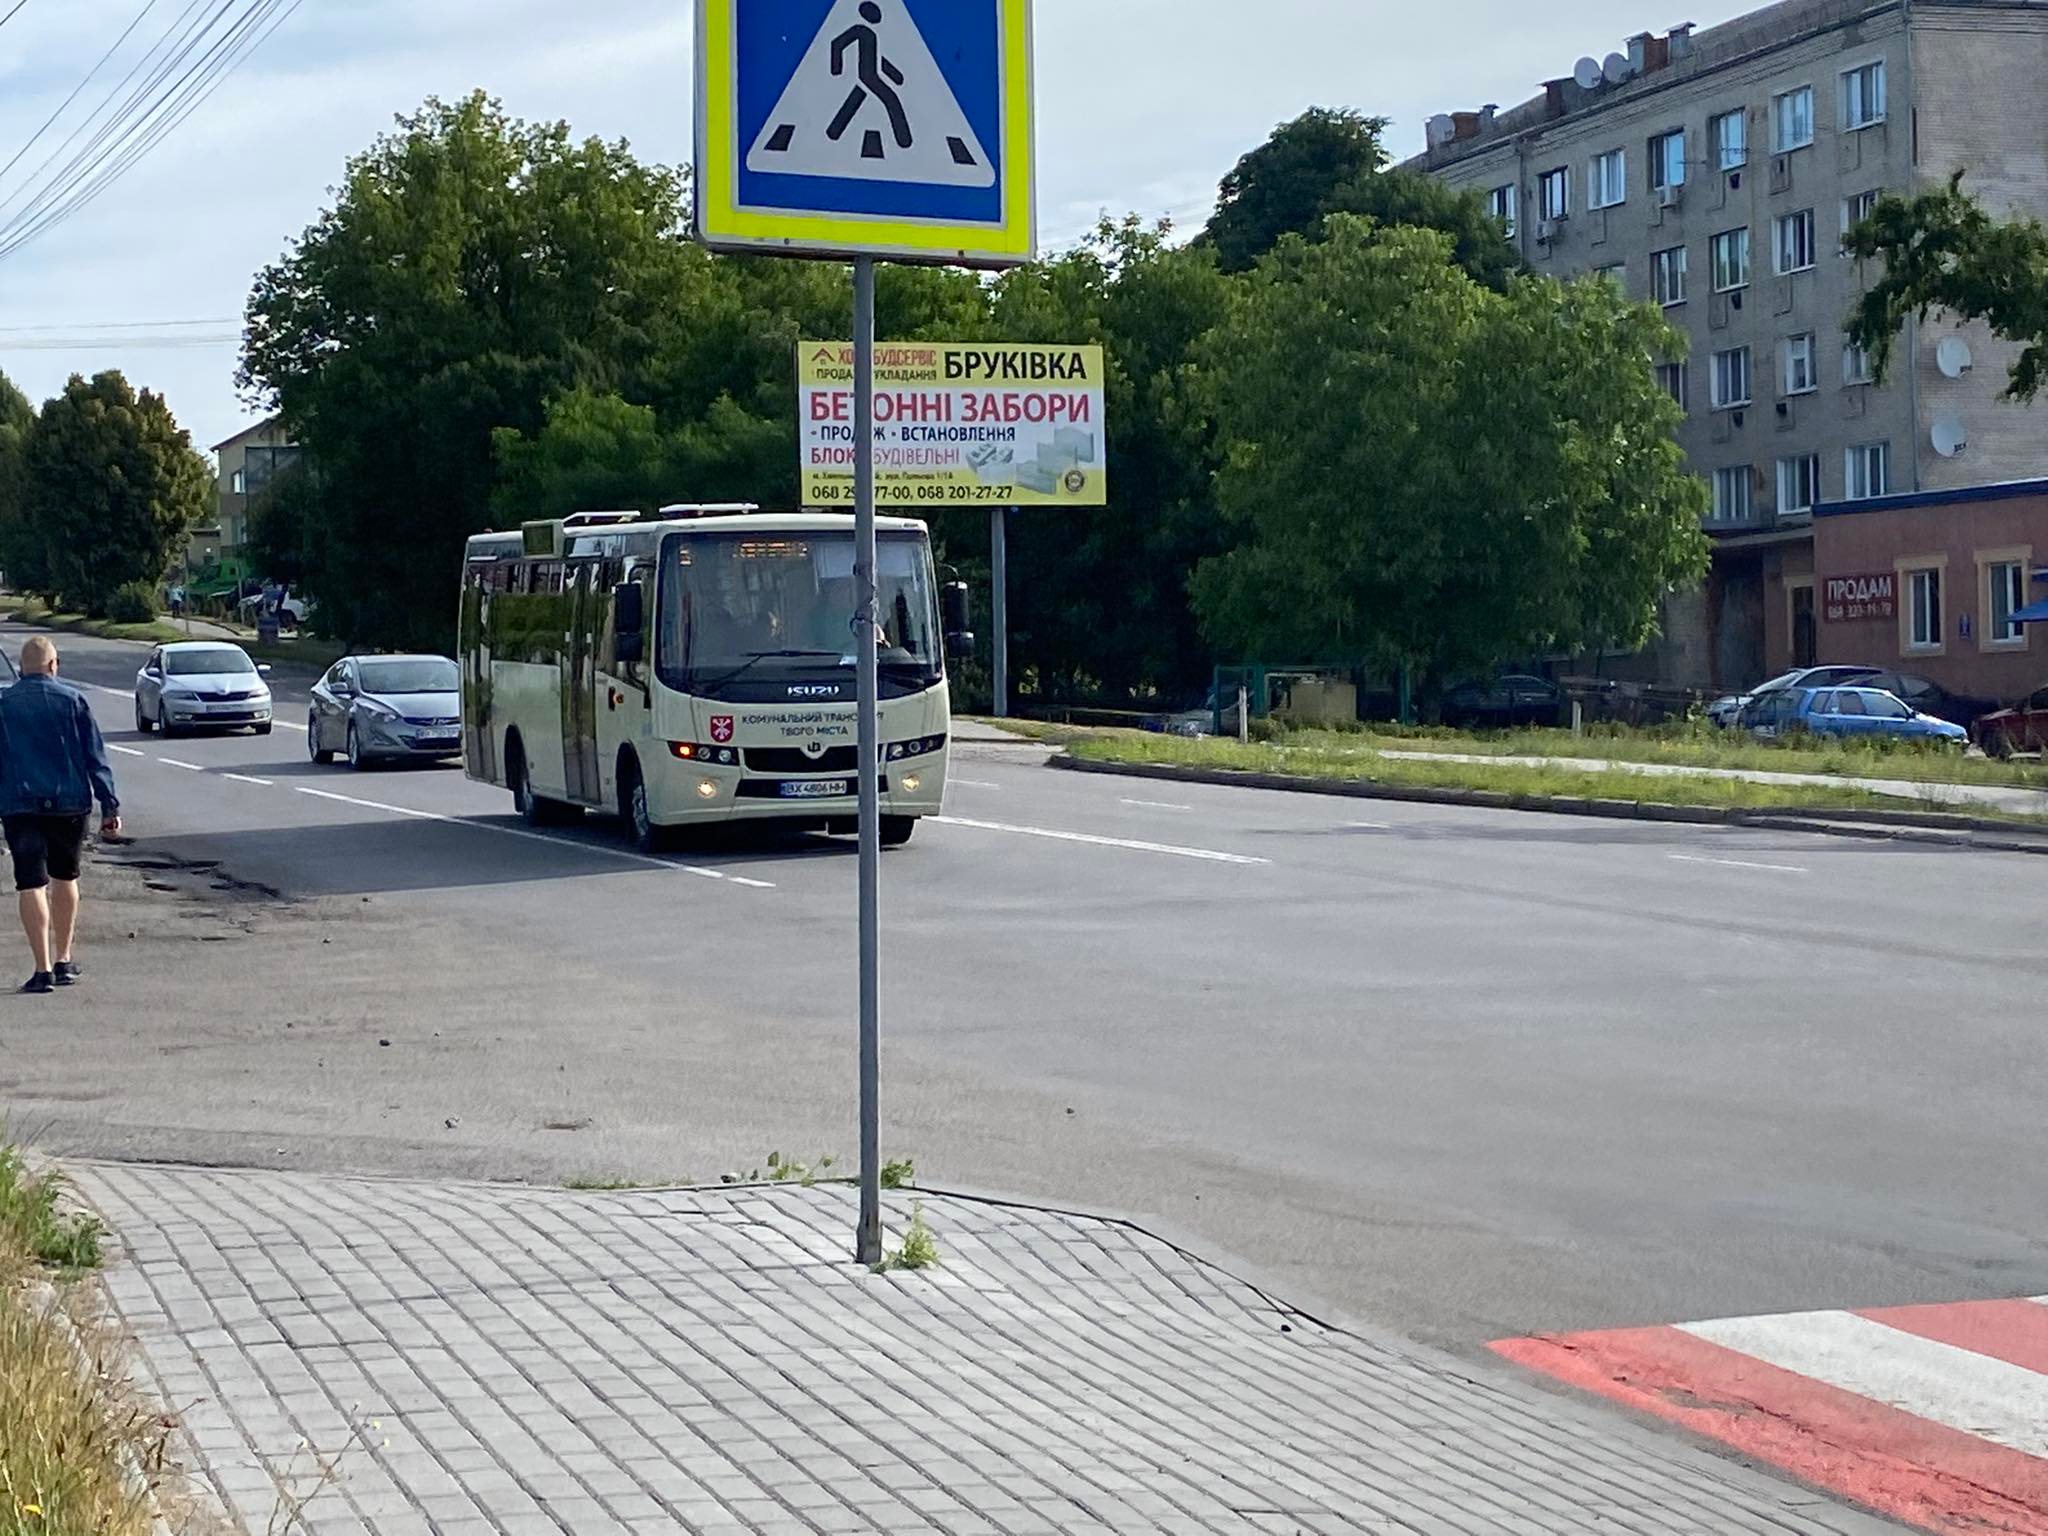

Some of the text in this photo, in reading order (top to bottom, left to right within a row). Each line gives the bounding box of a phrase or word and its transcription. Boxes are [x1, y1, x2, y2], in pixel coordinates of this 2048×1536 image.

[838, 348, 937, 367] ХОБУДСЕРВІС
[944, 351, 1087, 380] БРУКІВКА
[816, 368, 937, 382] ПРОДА УКЛАДАННЯ
[961, 393, 1089, 422] ЗАБОРИ
[821, 426, 1016, 442] ПРОЖ ВСТАНОВЛЕННЯ
[811, 447, 959, 467] БЛОК БУДІВЕЛЬНІ
[812, 486, 839, 499] 068
[917, 486, 944, 499] 068
[949, 486, 1013, 499] 201-27-27
[1828, 576, 1892, 603] ПРОДАМ
[787, 685, 840, 696] ISUZU
[742, 712, 884, 724] КОМУНАЛЬНИЙ ТРАНСТ
[780, 726, 848, 736] ТВОГО МІСТА
